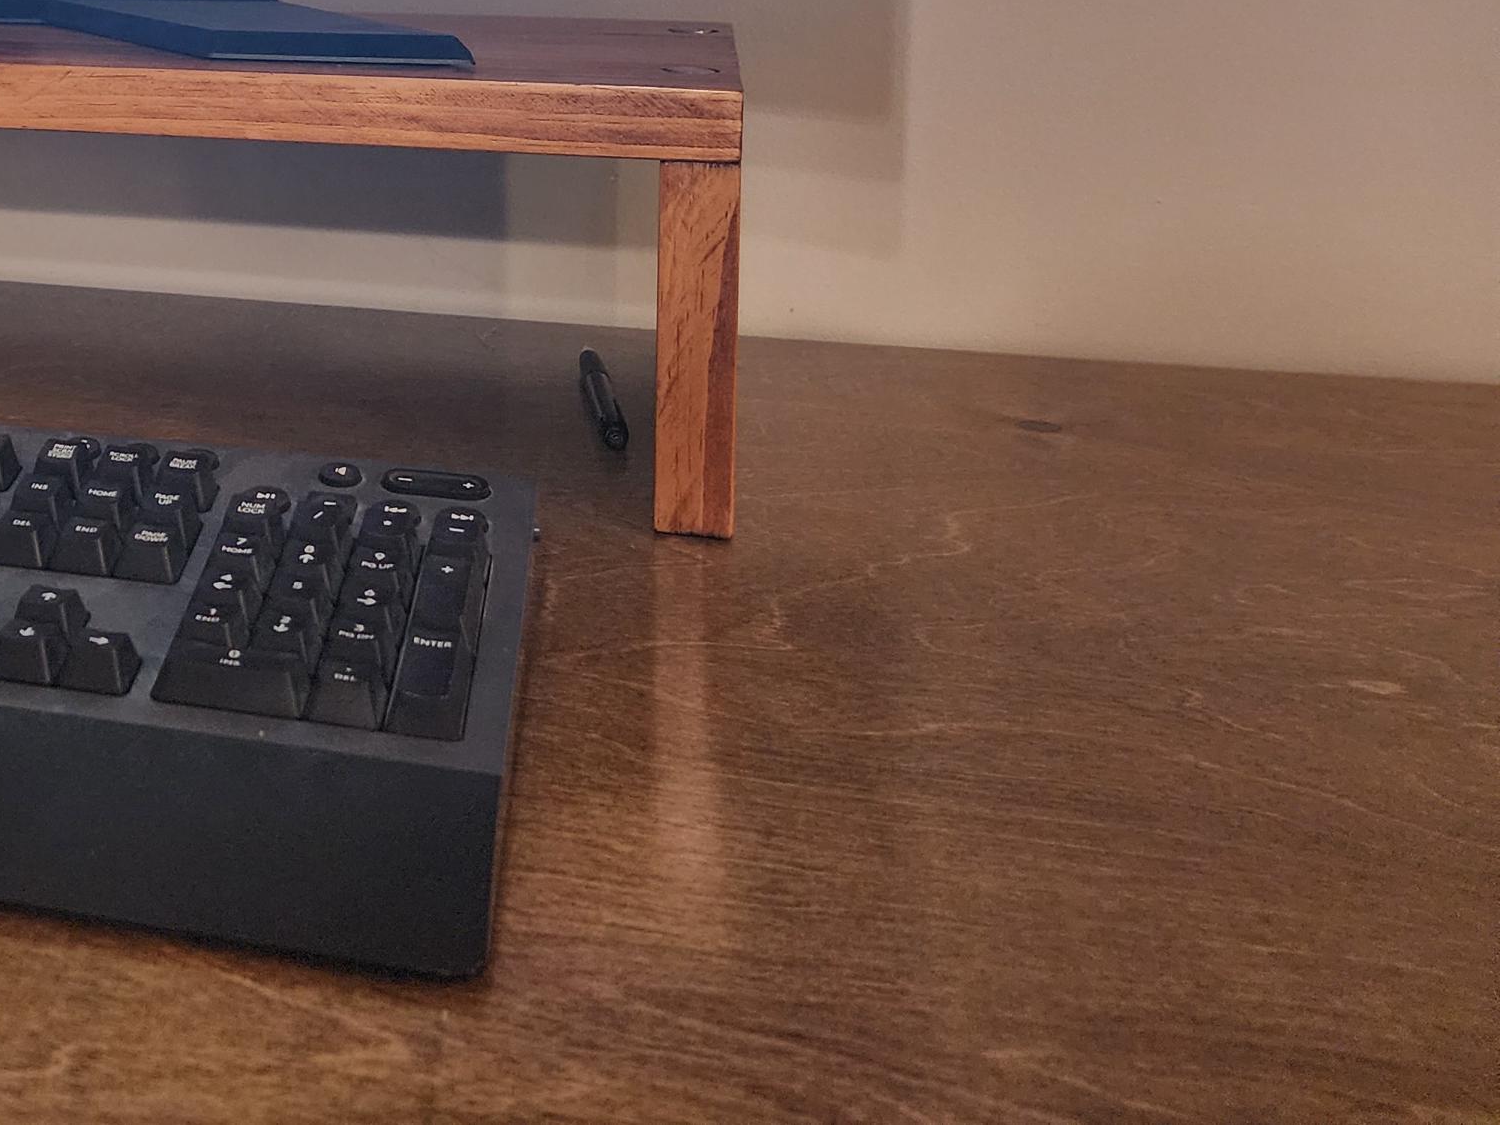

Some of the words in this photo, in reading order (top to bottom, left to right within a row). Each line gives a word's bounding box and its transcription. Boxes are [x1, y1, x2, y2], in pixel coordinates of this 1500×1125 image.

[31, 482, 49, 490] INS
[88, 488, 118, 497] HOME
[155, 492, 180, 500] PAGE
[238, 506, 265, 514] LOCK
[12, 519, 31, 527] DEL
[75, 525, 98, 533] END
[222, 544, 253, 554] HOME
[413, 636, 452, 648] ENTER
